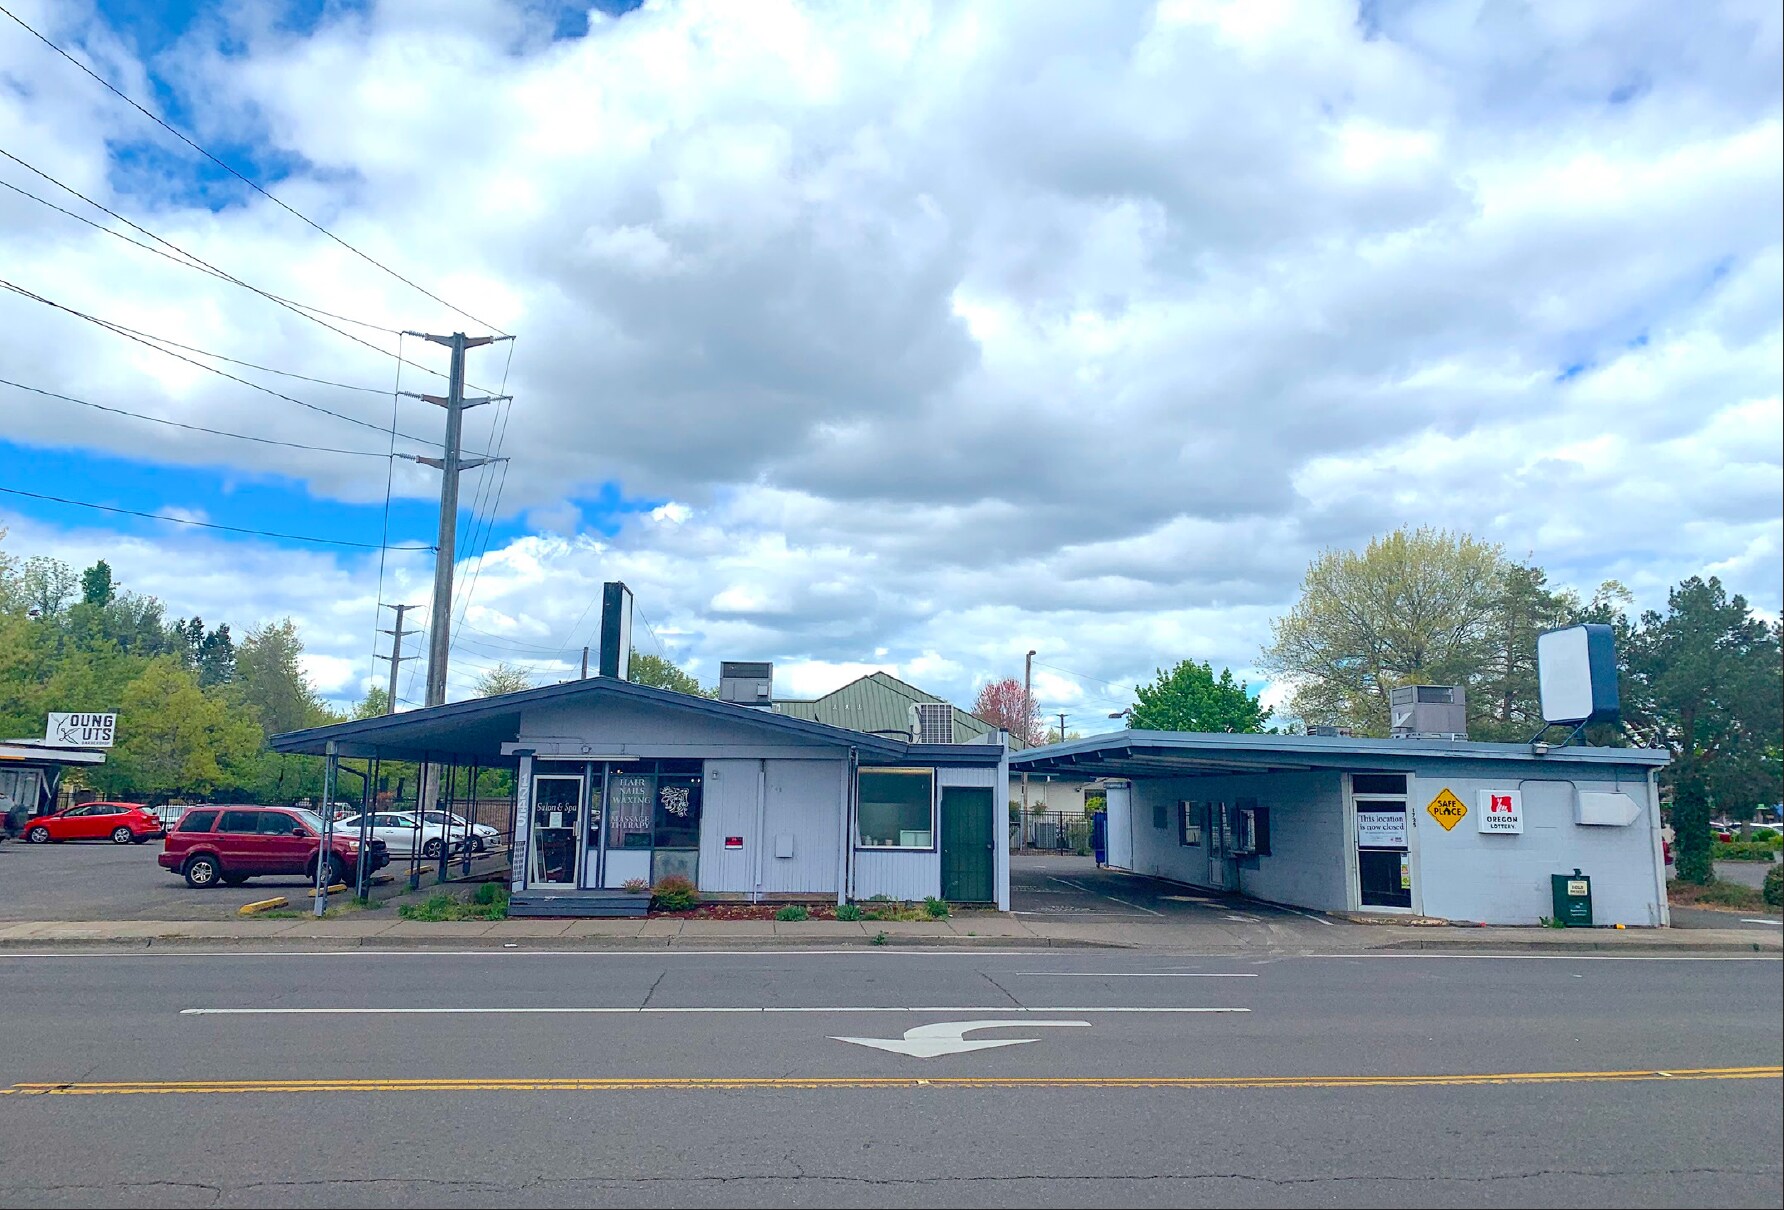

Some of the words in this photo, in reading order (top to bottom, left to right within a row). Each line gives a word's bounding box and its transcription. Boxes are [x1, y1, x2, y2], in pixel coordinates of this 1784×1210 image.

[620, 778, 645, 786] HAIR
[619, 787, 645, 795] NAILS
[612, 796, 651, 804] WAXING
[1437, 800, 1457, 808] SAFE
[537, 802, 556, 812] Salon
[557, 802, 563, 812] &
[564, 802, 577, 814] Spa
[1433, 807, 1462, 816] PLACE
[1359, 814, 1375, 822] This
[1382, 822, 1405, 831] closed
